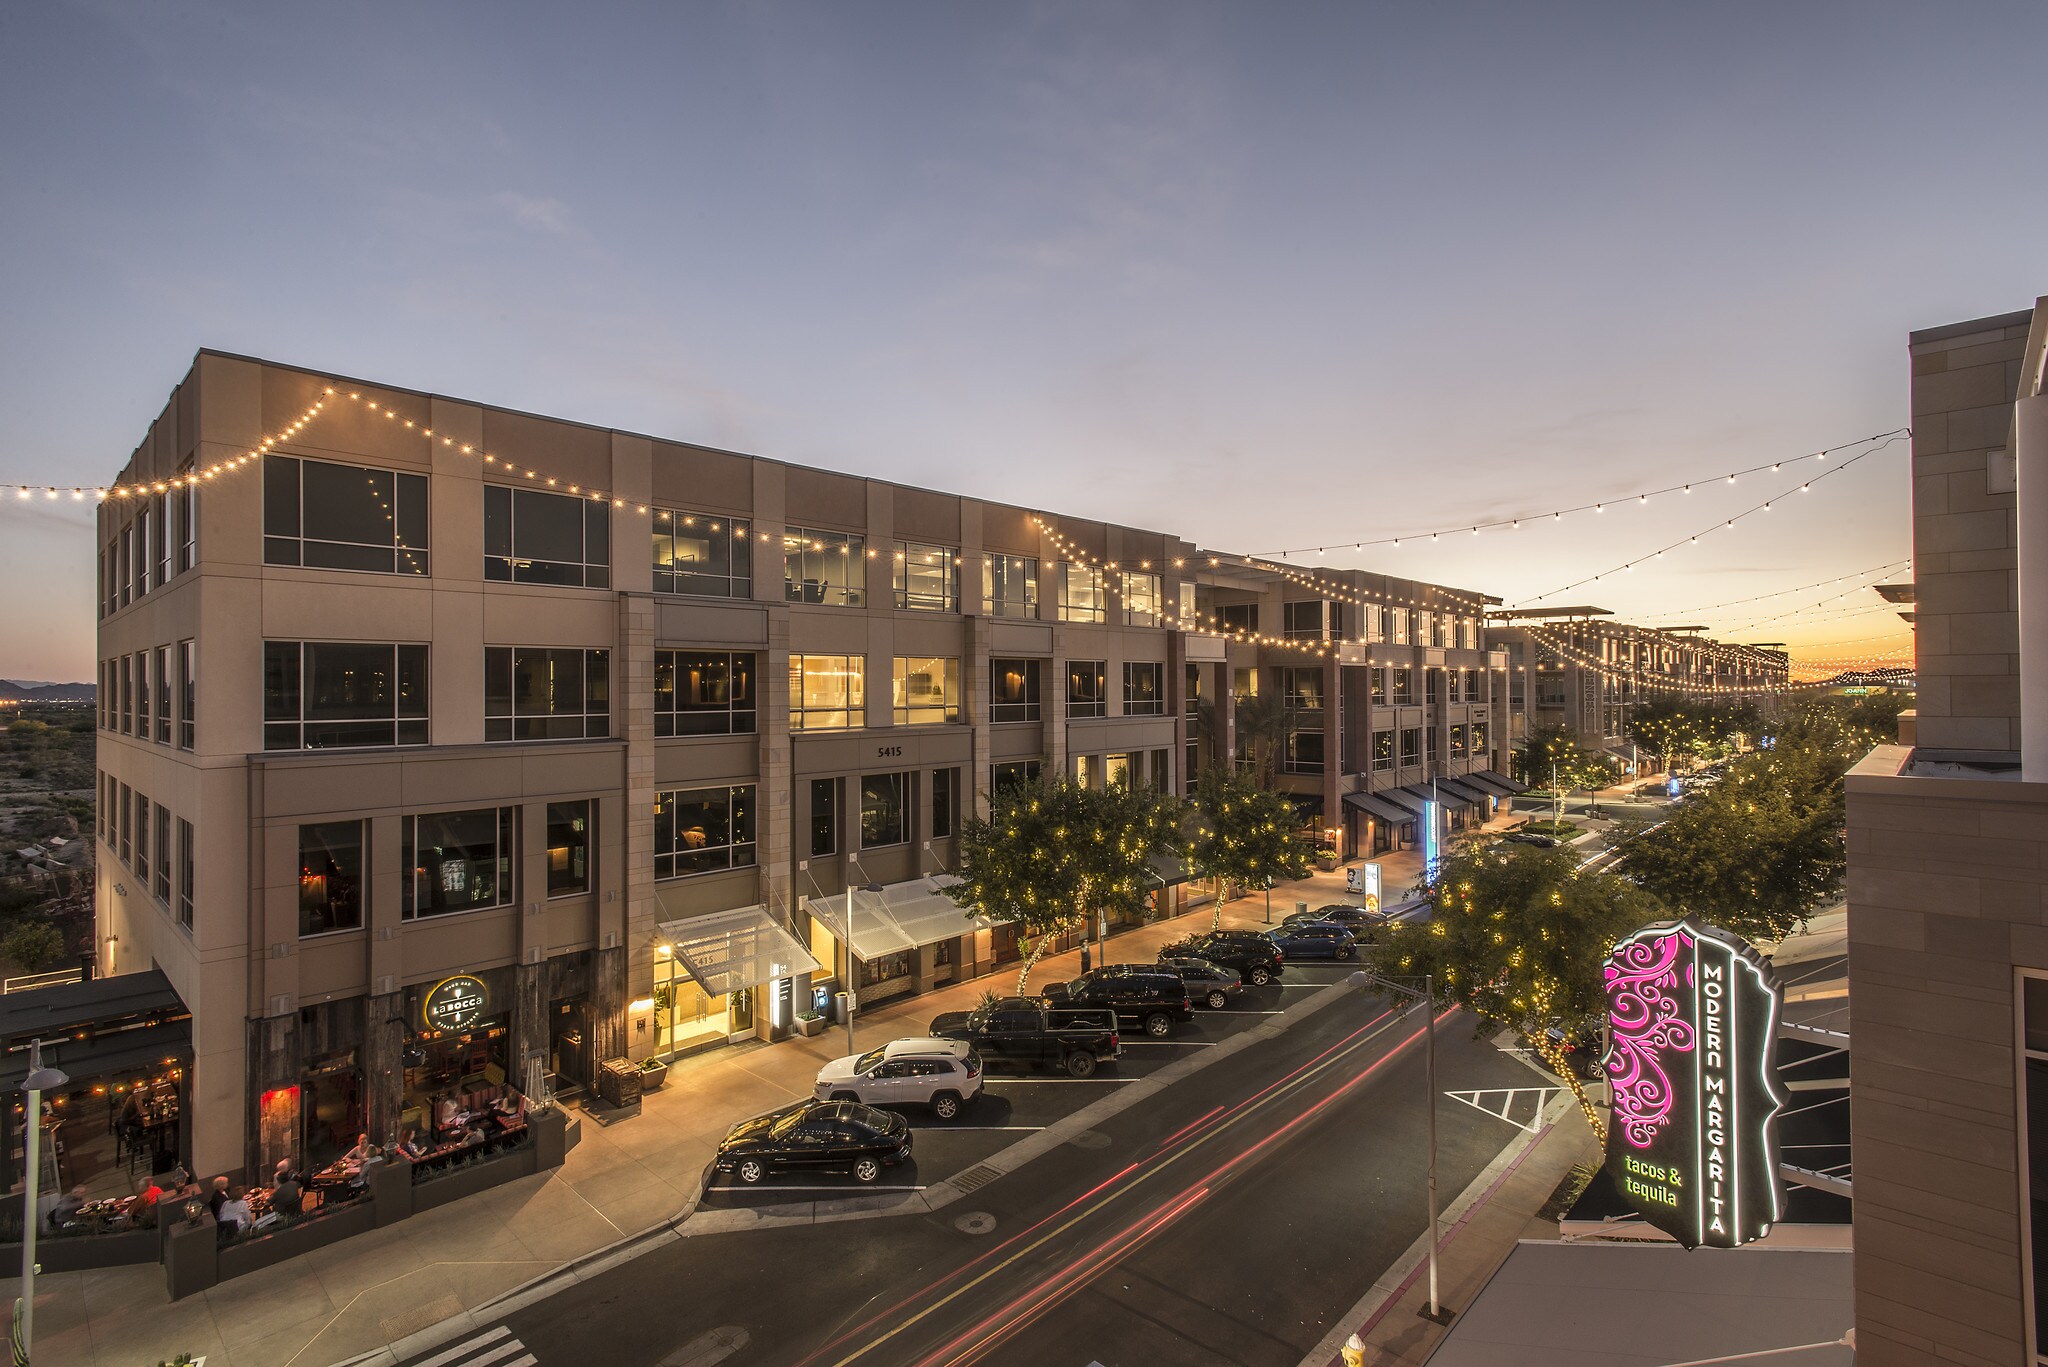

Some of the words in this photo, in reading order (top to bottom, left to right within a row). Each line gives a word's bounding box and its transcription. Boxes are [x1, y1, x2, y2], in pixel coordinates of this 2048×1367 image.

[1584, 644, 1596, 714] RSDENCES
[877, 746, 902, 757] 5415
[1704, 962, 1724, 1069] MODERN
[1625, 1155, 1666, 1181] tacos
[1669, 1168, 1682, 1187] &
[1706, 1076, 1725, 1234] MARGARITA
[1626, 1176, 1677, 1207] tequila
